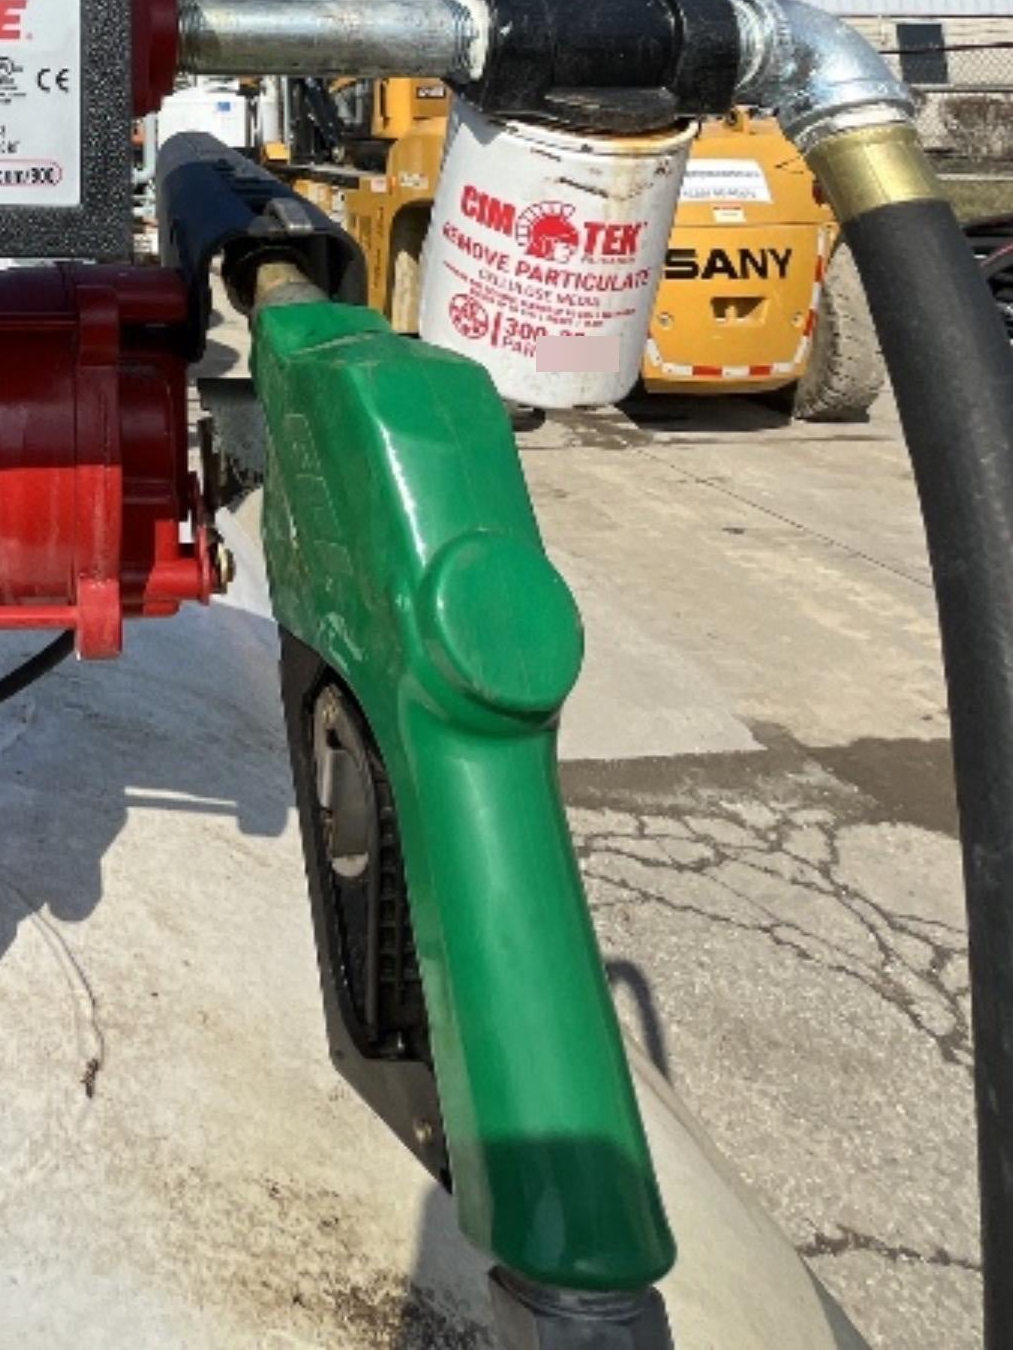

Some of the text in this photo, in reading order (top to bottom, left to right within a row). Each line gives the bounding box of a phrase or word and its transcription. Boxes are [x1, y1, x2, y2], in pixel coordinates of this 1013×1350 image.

[460, 185, 643, 257] CIM TEK
[664, 248, 793, 280] SANY
